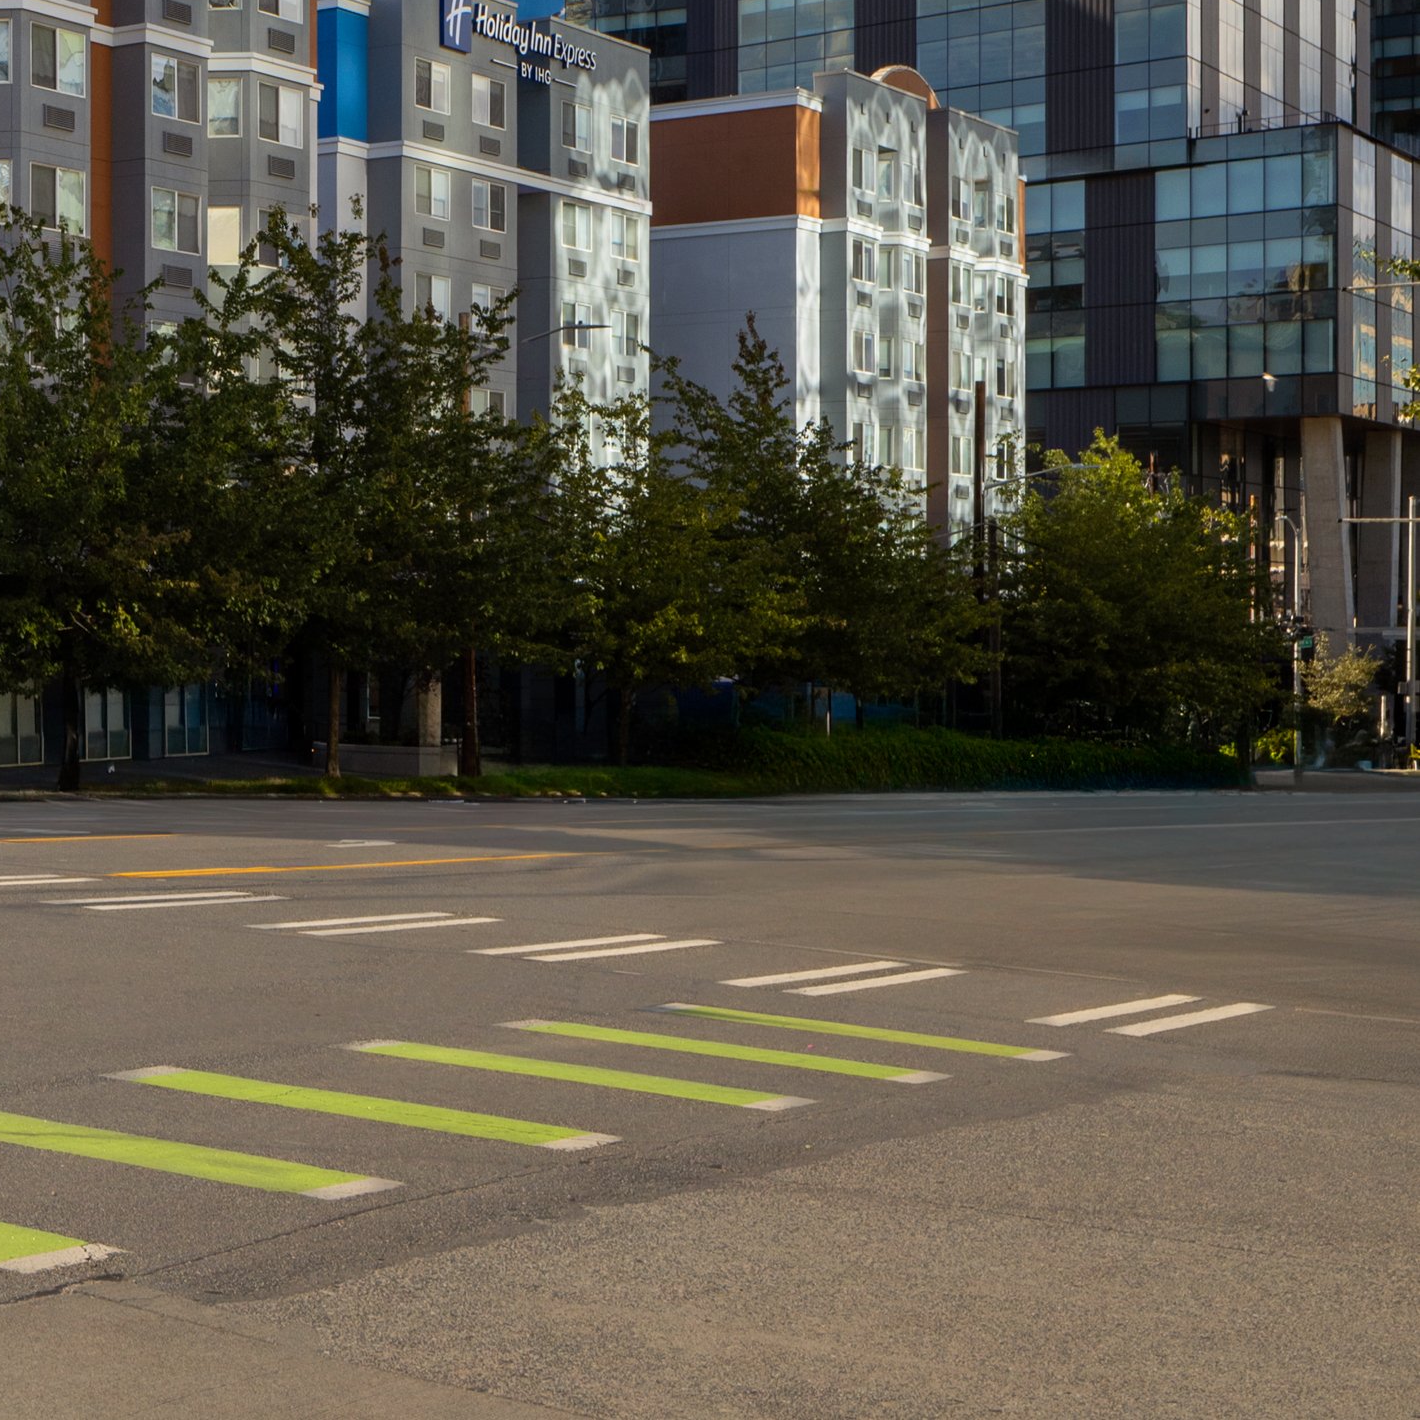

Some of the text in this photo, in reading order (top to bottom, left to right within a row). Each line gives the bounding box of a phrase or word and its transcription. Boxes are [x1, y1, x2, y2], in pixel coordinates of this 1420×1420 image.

[475, 2, 597, 71] Holiday Inn Express
[521, 62, 552, 85] BY IHG
